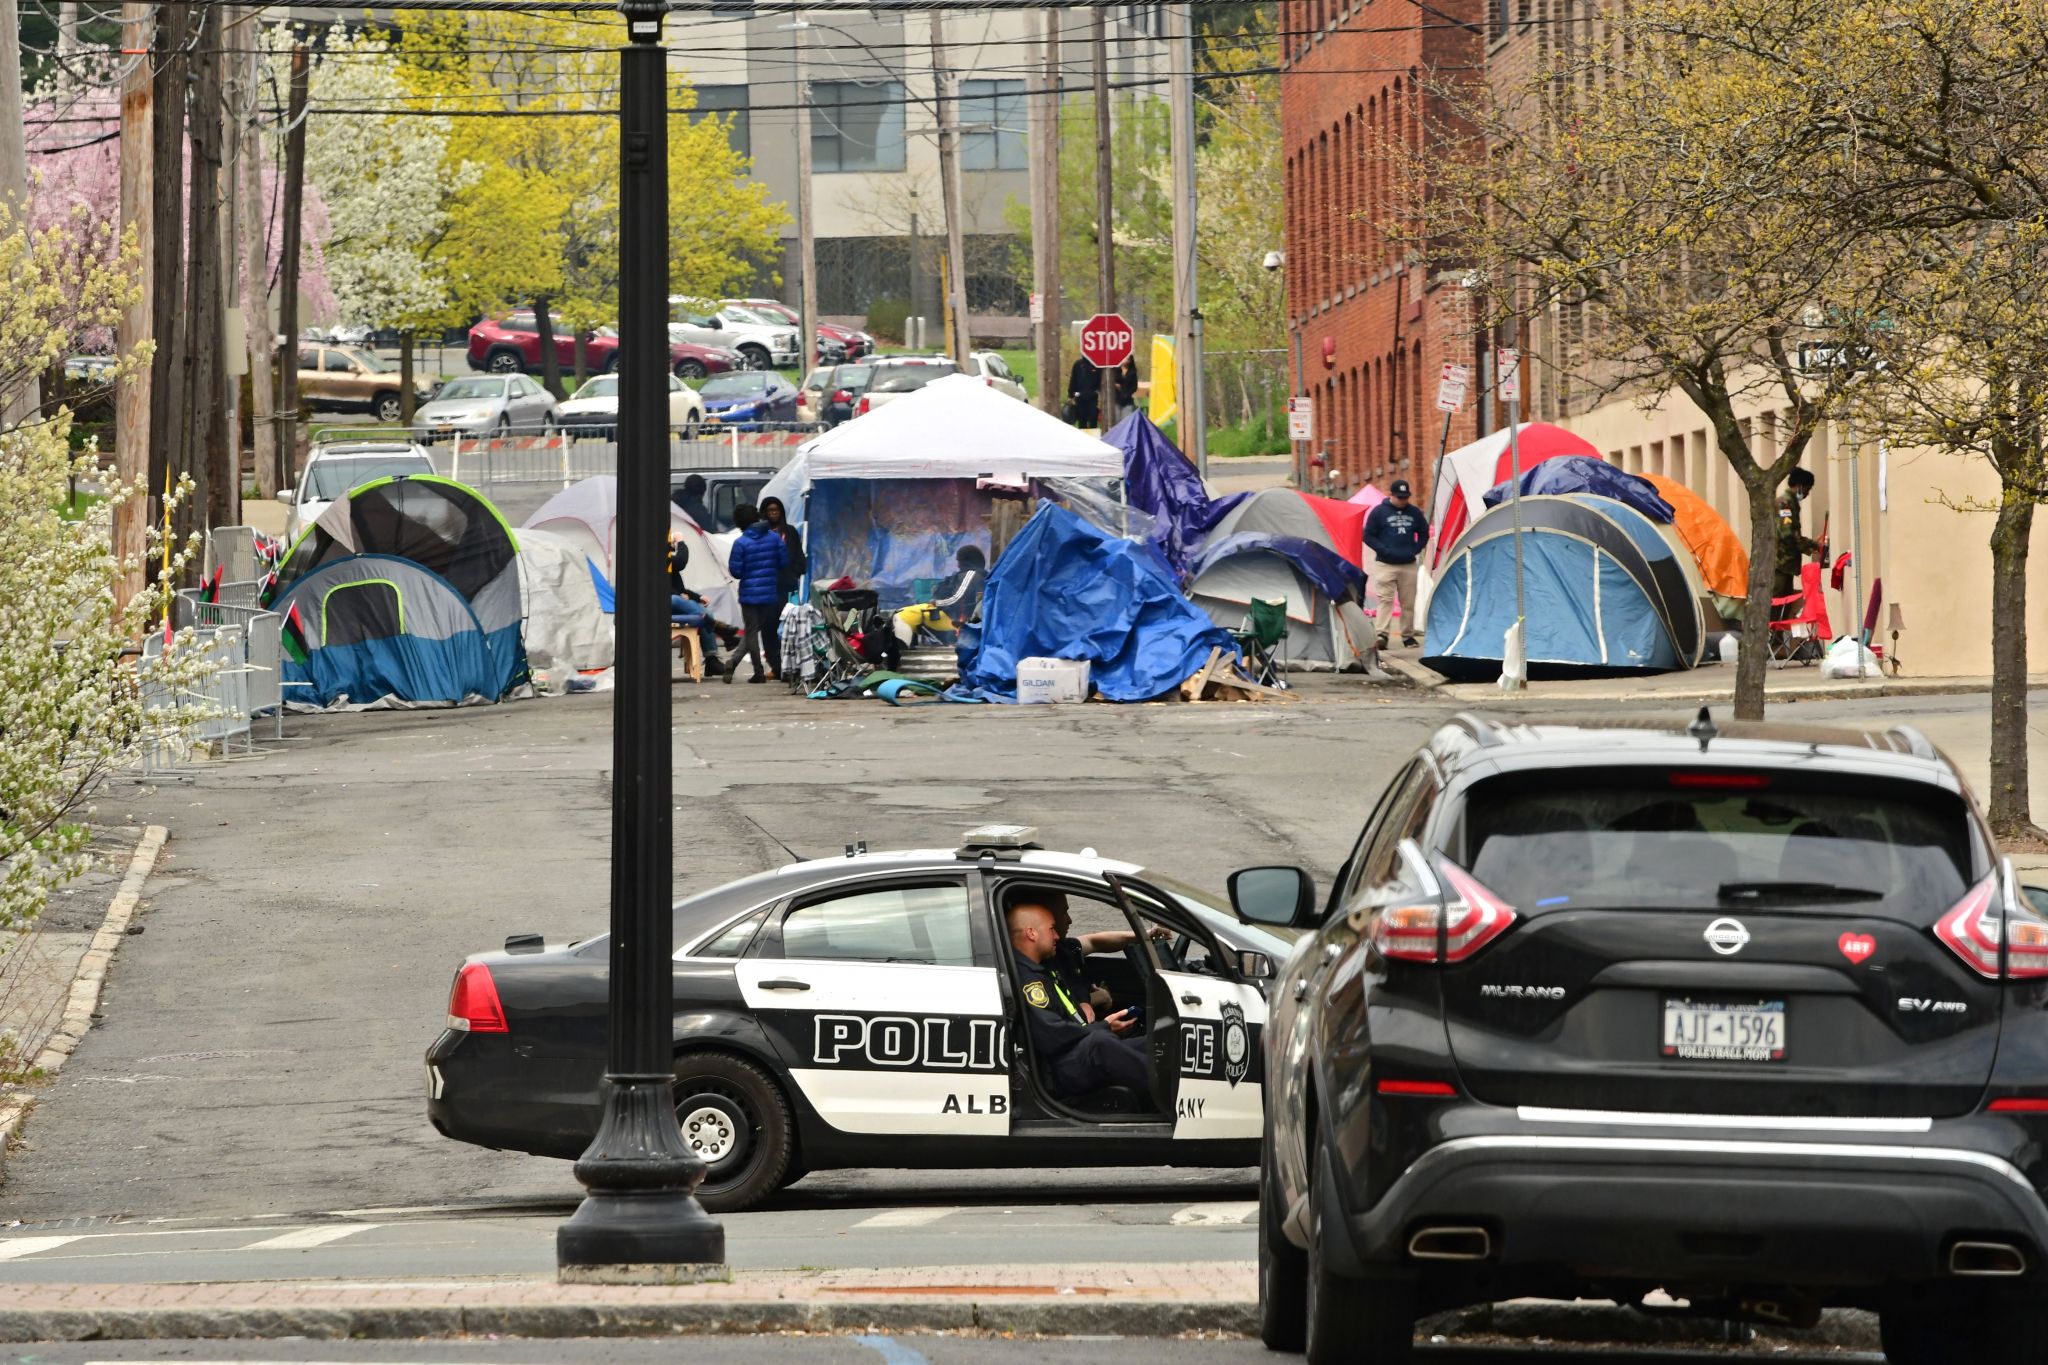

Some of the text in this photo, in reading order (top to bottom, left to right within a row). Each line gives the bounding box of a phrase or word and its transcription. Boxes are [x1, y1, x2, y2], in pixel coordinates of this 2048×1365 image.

[1084, 331, 1130, 351] STOP
[1022, 679, 1056, 687] GILDAN
[1844, 940, 1871, 954] ART
[1481, 984, 1566, 1000] MURANO
[1222, 1006, 1244, 1020] ALBANY
[1674, 1014, 1776, 1045] AJT 1596
[813, 1014, 1009, 1069] POLI
[1677, 1045, 1772, 1060] VOLLEYBALL MOM
[1226, 1061, 1245, 1077] POLICE
[941, 1094, 1206, 1118] ALB ANY
